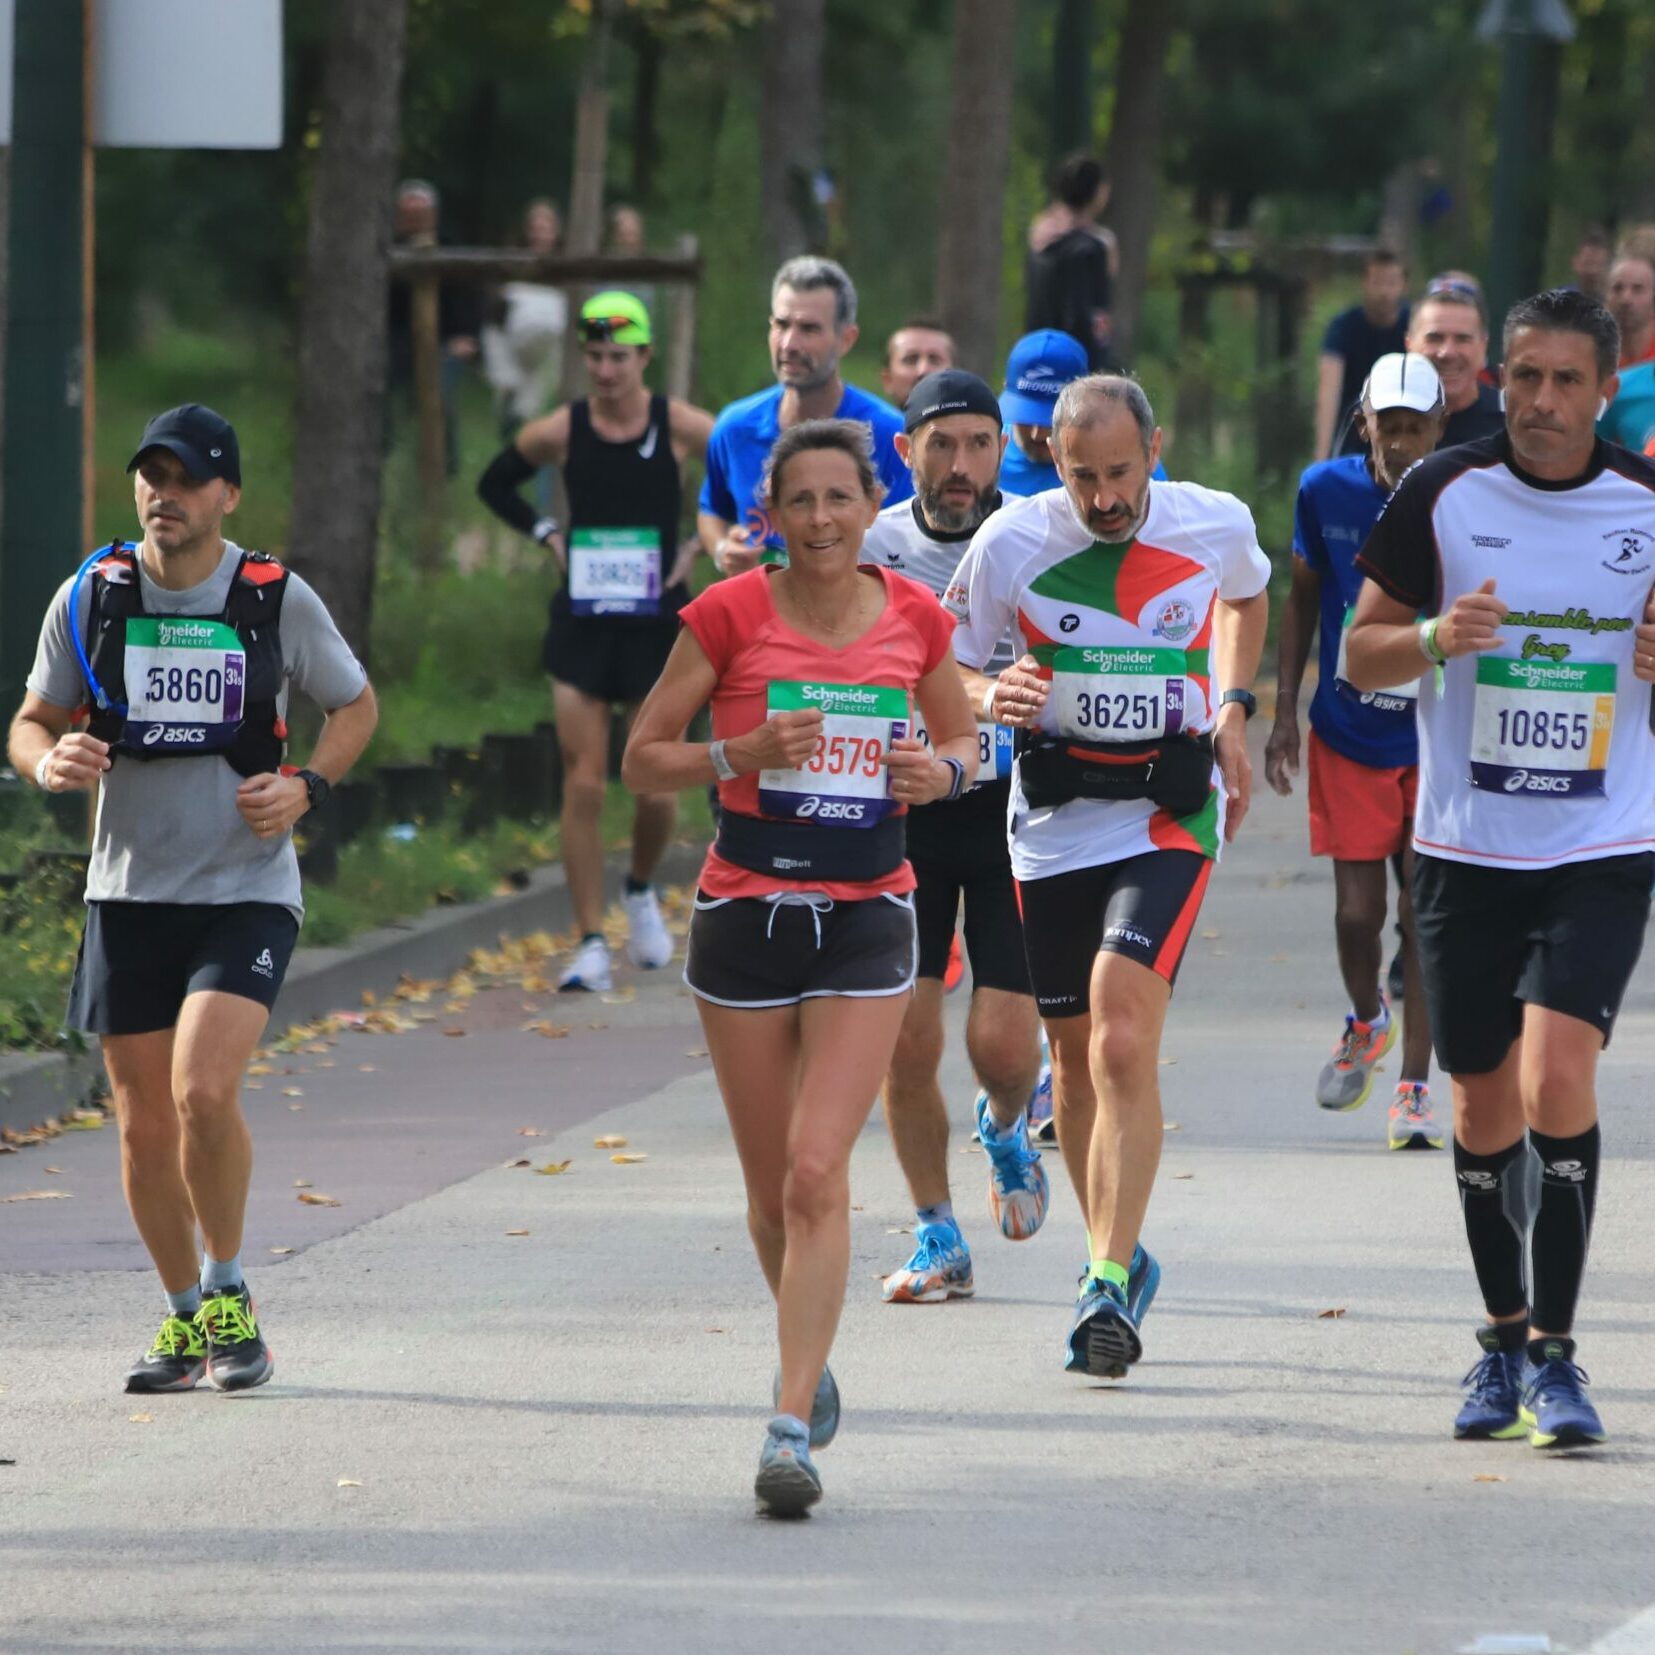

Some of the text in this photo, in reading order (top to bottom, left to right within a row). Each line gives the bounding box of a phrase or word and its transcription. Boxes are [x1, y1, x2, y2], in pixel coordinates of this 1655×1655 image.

[1017, 378, 1062, 394] BROOKS
[172, 637, 213, 646] Electric
[1083, 650, 1156, 664] Schneider
[1113, 664, 1154, 672] Electric
[1508, 663, 1587, 680] Schneider
[1541, 679, 1585, 689] Electric
[802, 685, 879, 704] Schneider
[834, 704, 877, 713] Electric
[1076, 693, 1159, 730] 36251
[1373, 696, 1408, 712] asics
[164, 728, 206, 743] asics
[1498, 709, 1588, 751] 10855
[795, 735, 882, 778] 3579
[1526, 774, 1572, 792] asics
[818, 802, 866, 819] asics
[1039, 996, 1068, 1005] CRAFT
